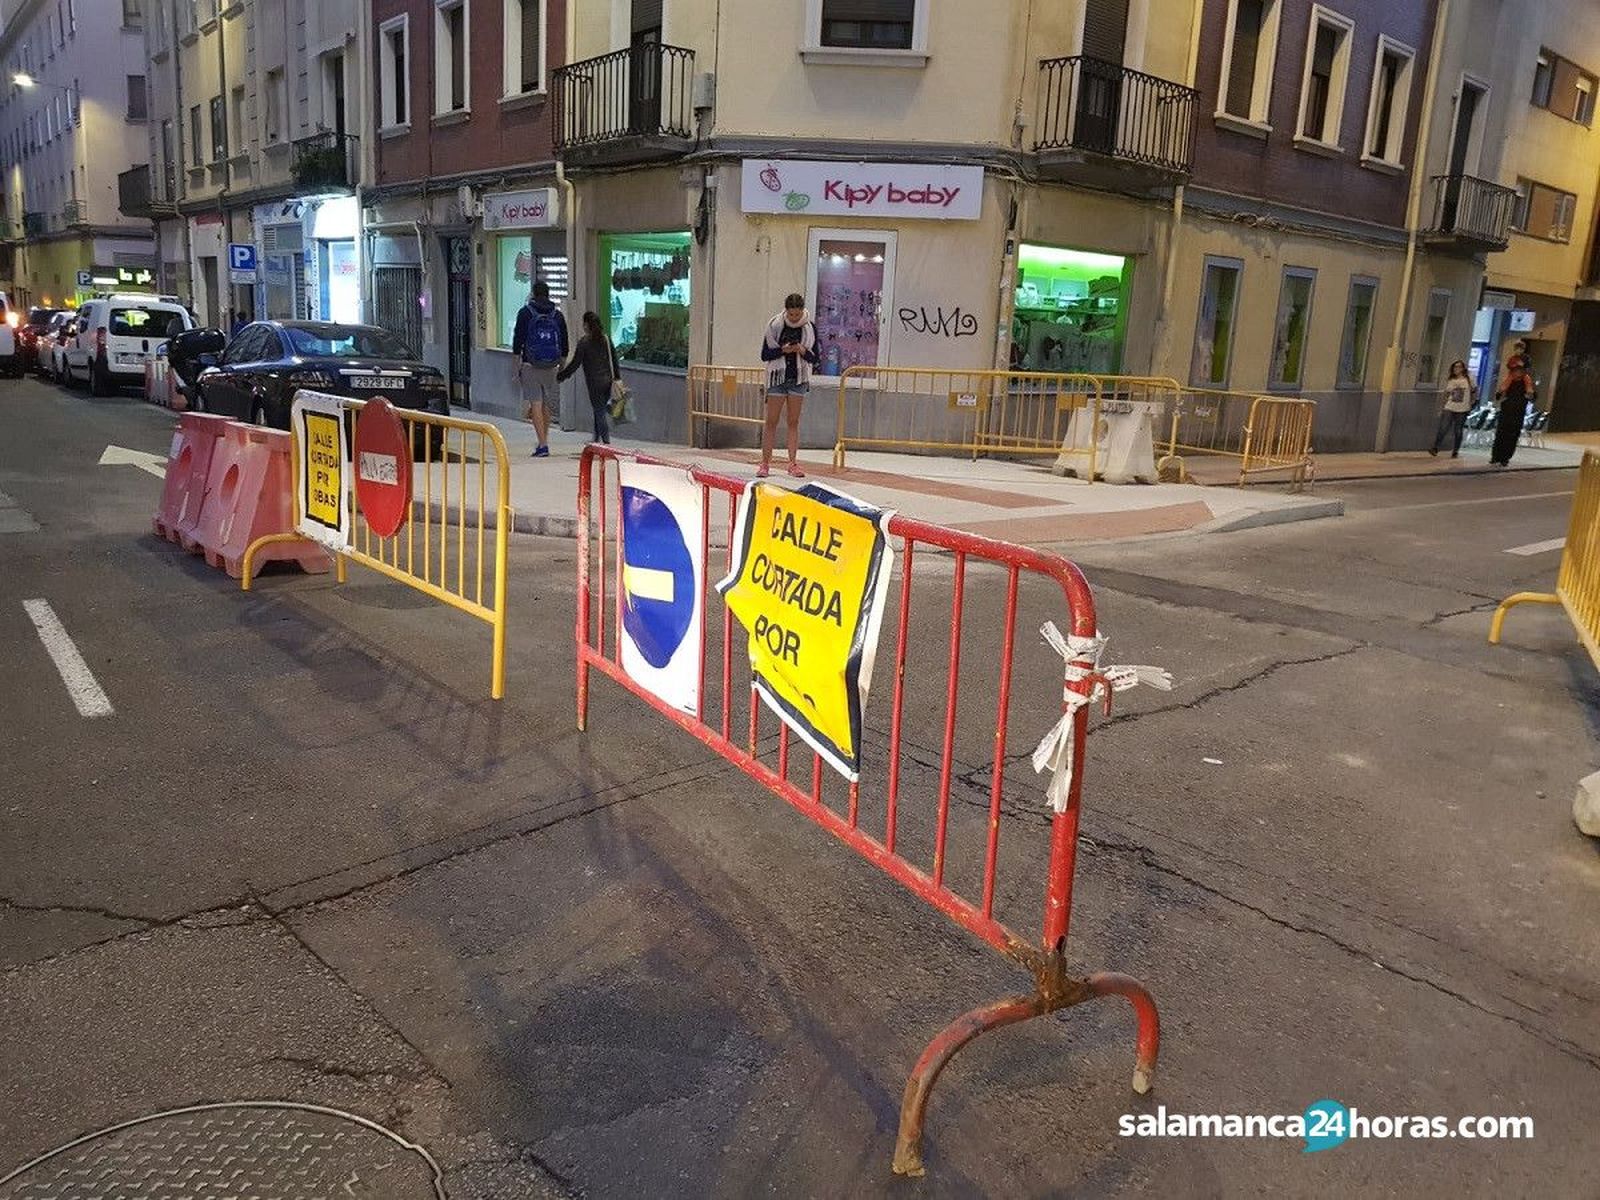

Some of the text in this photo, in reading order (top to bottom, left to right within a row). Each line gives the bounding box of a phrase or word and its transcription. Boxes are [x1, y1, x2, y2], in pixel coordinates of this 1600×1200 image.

[522, 201, 548, 218] baby
[824, 180, 960, 208] Kipy baby
[233, 246, 251, 267] P
[771, 506, 843, 562] CALLE
[751, 553, 843, 627] CORTADA
[754, 615, 801, 666] POR
